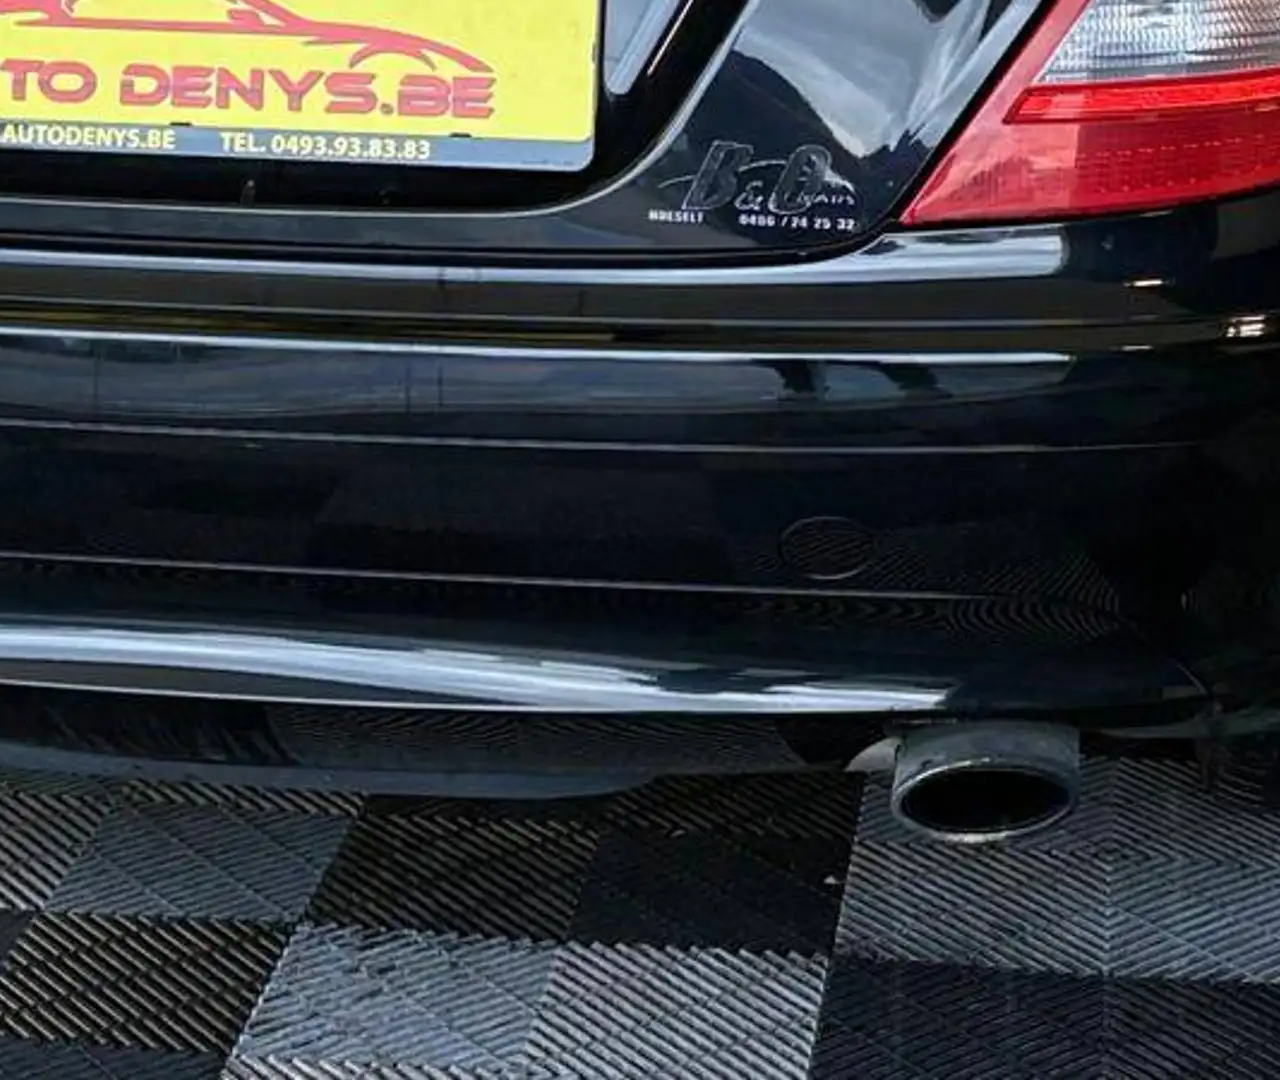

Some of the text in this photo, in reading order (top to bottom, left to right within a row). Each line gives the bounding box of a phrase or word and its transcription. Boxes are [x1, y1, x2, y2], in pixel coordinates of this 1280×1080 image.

[119, 62, 495, 119] DENYS.BE
[219, 130, 267, 154] TEL.
[271, 133, 432, 160] 0493.93.83.83
